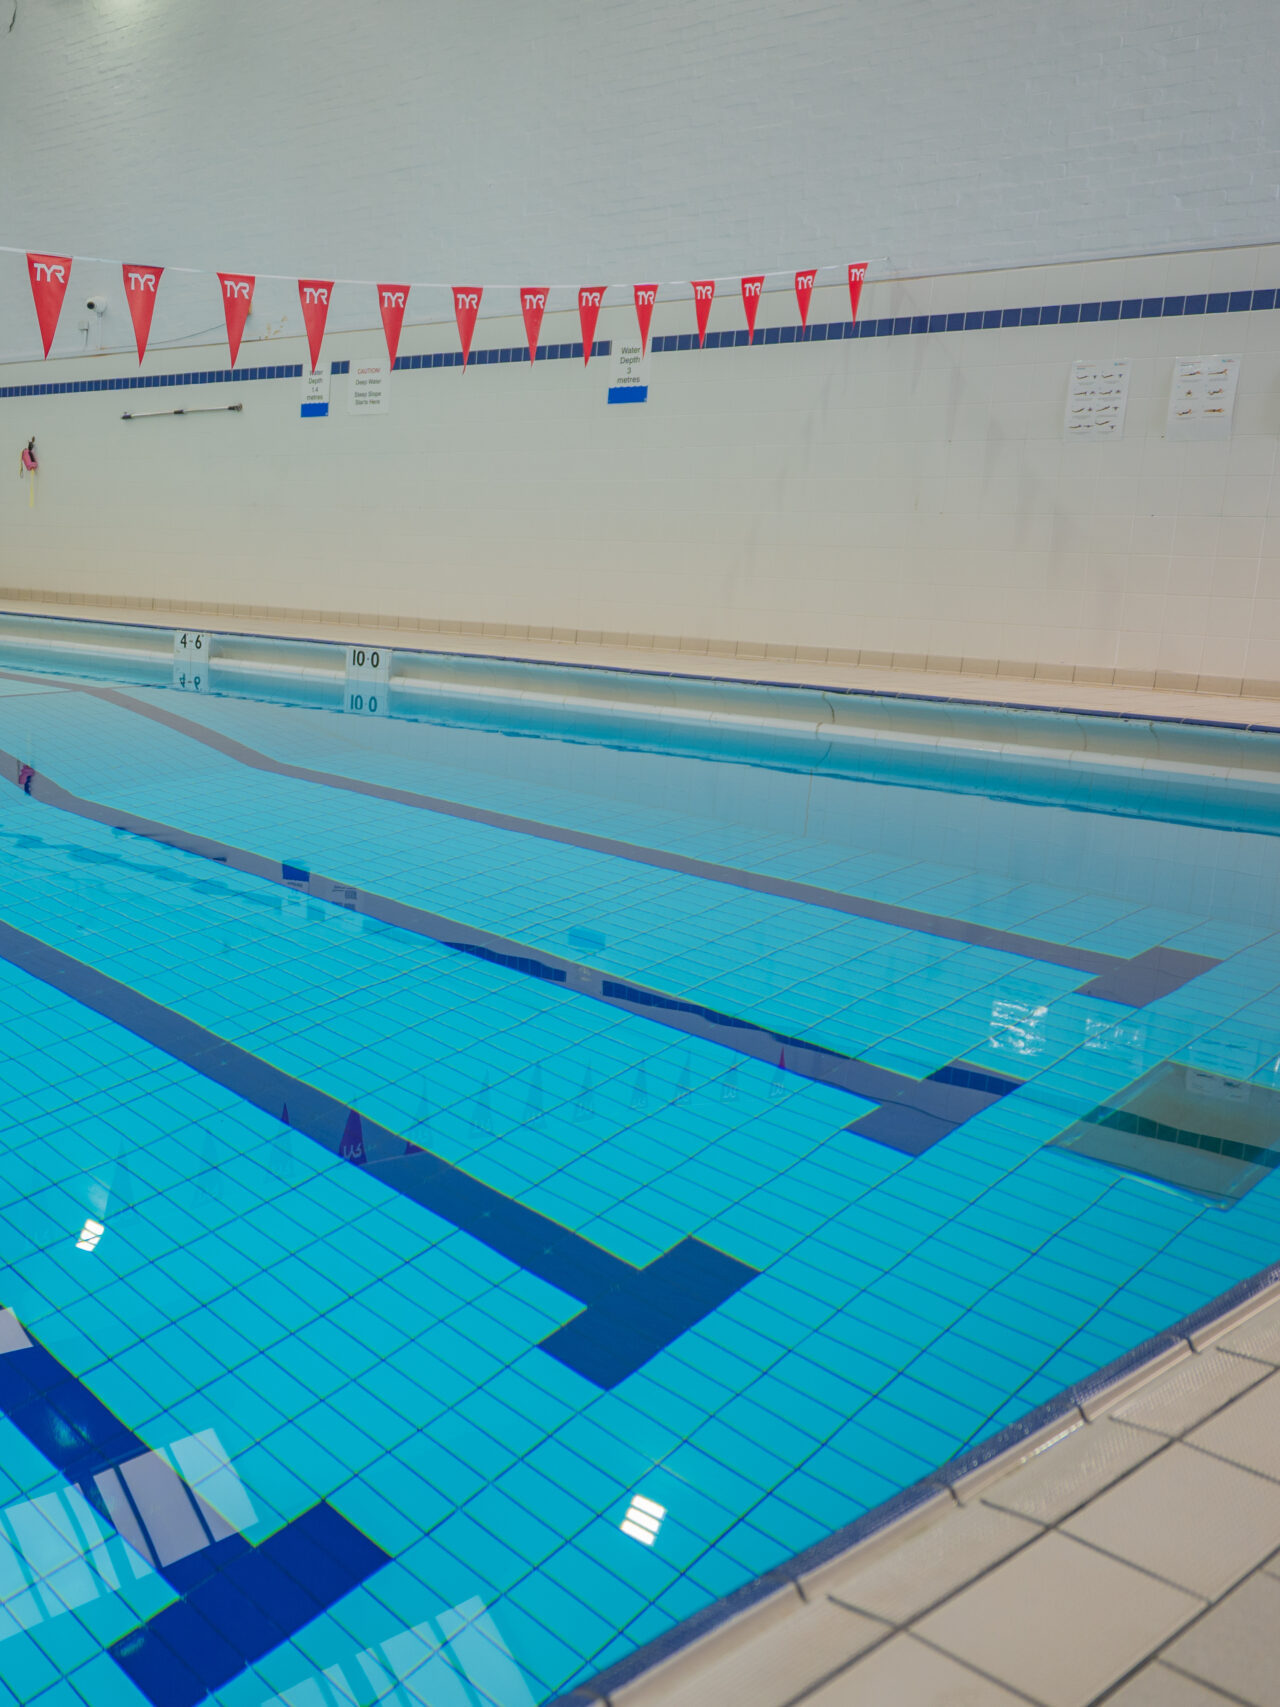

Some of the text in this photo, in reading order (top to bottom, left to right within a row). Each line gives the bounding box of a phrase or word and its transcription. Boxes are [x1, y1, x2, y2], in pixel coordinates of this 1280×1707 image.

[34, 263, 64, 283] TYR
[128, 273, 155, 292] TYR
[744, 282, 760, 296] TYR
[798, 276, 812, 290] TYR
[224, 281, 250, 300] TYR
[304, 288, 327, 304] TYR
[638, 291, 654, 304] TYR
[696, 286, 712, 300] TYR
[382, 292, 404, 308] TYR
[457, 294, 478, 309] TYR
[524, 295, 544, 309] TYR
[582, 292, 599, 306] TYR
[622, 346, 640, 354] Water
[620, 356, 640, 365] Depth
